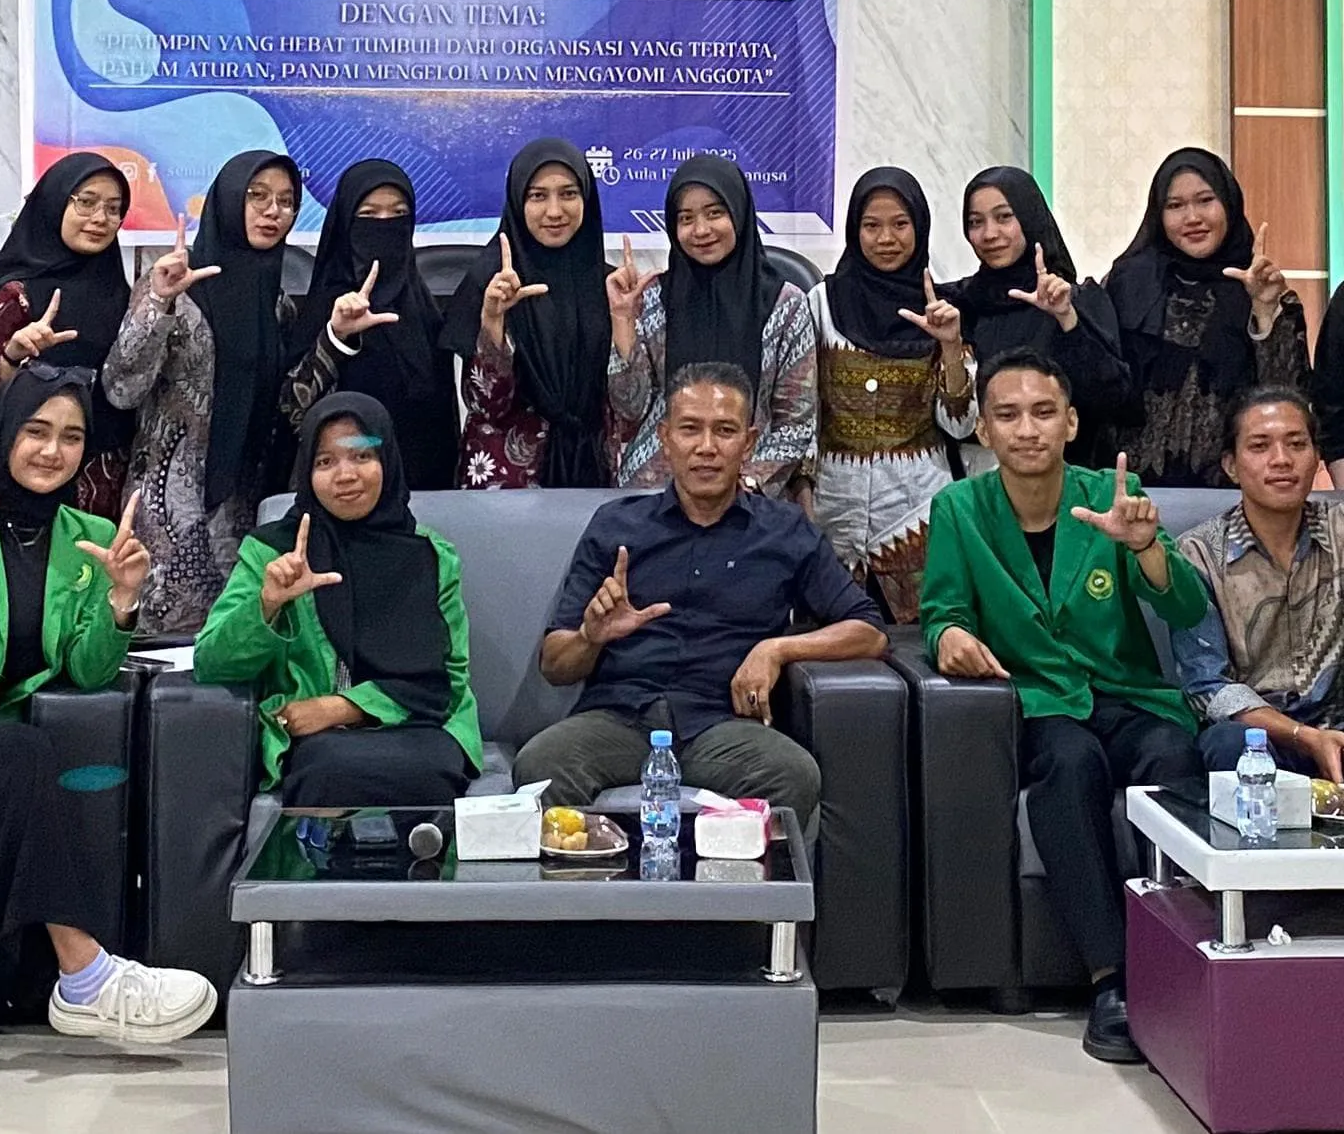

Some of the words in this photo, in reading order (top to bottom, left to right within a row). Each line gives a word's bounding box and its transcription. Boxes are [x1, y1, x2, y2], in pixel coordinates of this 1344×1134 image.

[341, 2, 453, 25] DENGAN
[464, 5, 546, 27] TEMA:
[218, 34, 274, 53] YANG
[280, 36, 346, 54] HEBAT
[352, 37, 440, 55] TUMBUH
[447, 38, 495, 56] DARI
[502, 39, 623, 57] ORGANISASI
[630, 40, 684, 58] YANG
[689, 41, 778, 62] TERTATA,
[102, 60, 178, 79] PAHAM
[185, 61, 276, 82] ATURAN,
[281, 63, 360, 80] PANDAI
[366, 64, 489, 82] MENGELOLA
[496, 65, 539, 83] DAN
[545, 66, 665, 84] MENGAYOMI
[623, 147, 667, 161] 26-27
[672, 147, 695, 161] Juli
[624, 167, 657, 181] Aula
[744, 170, 788, 184] angsa
